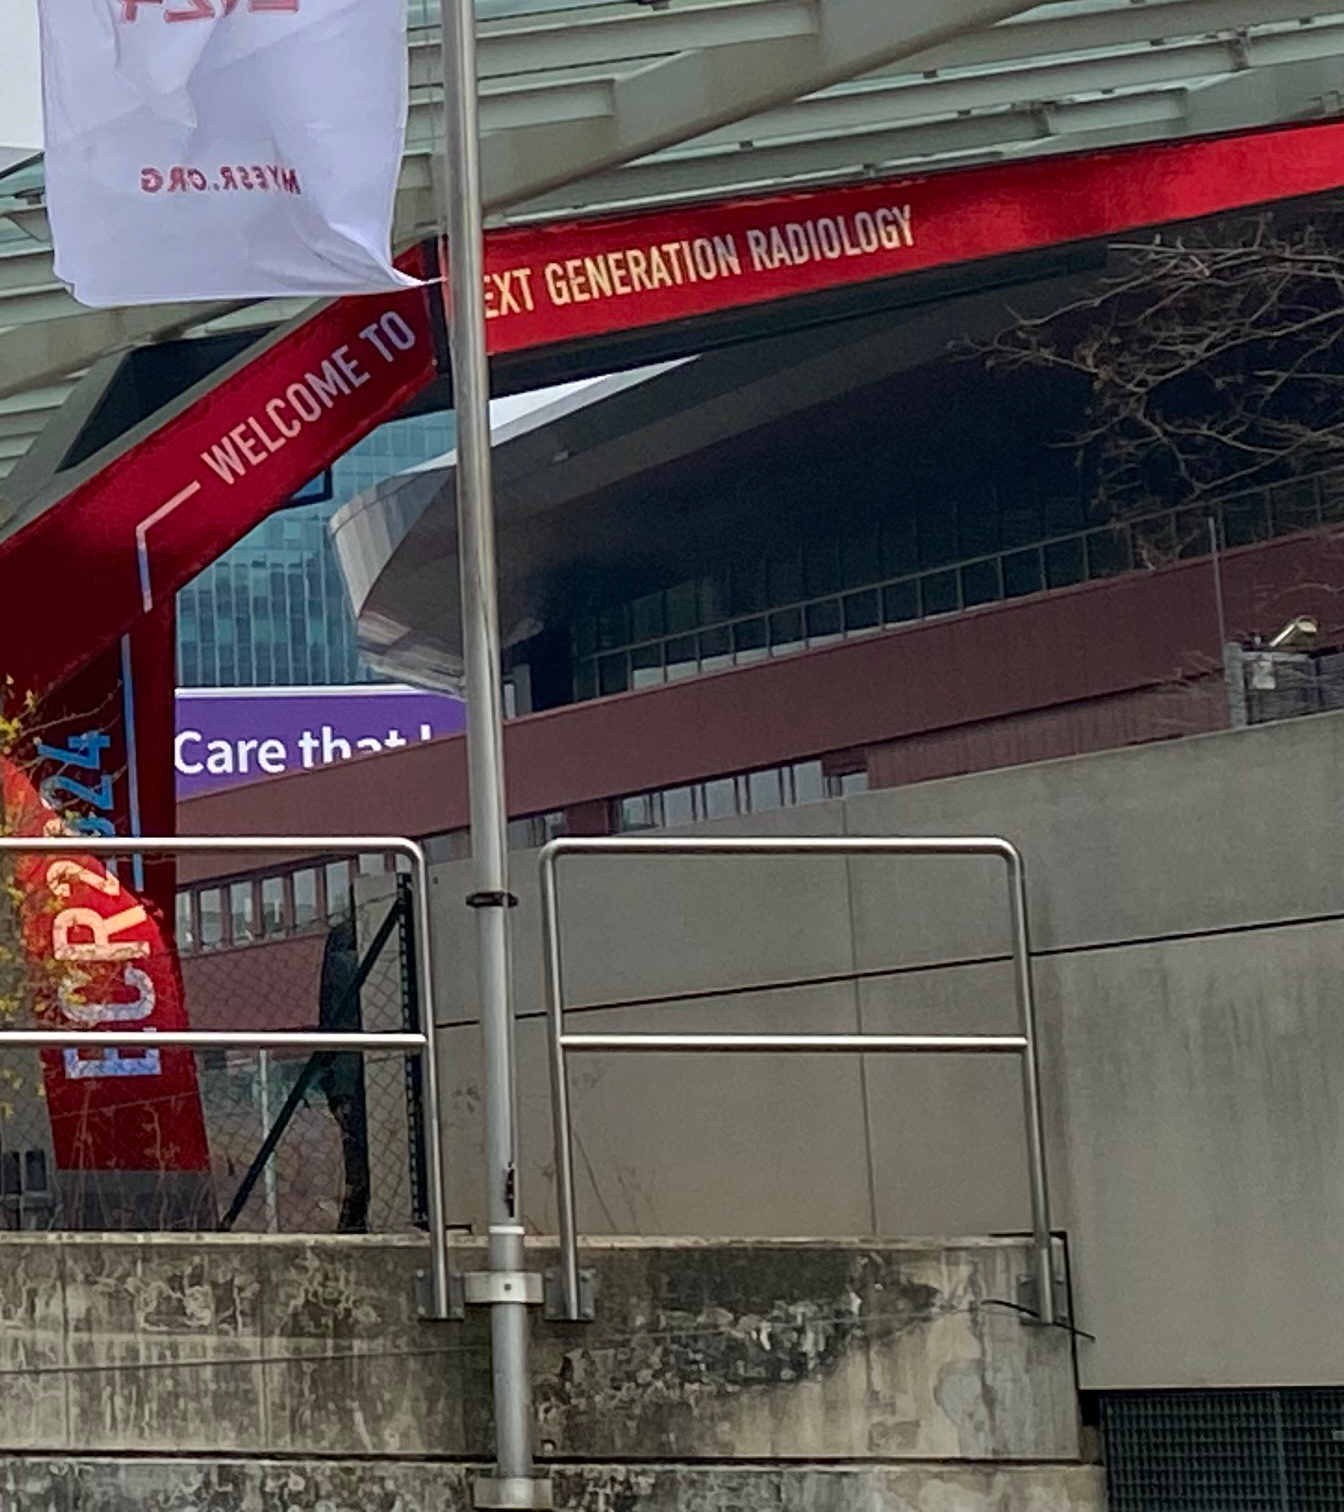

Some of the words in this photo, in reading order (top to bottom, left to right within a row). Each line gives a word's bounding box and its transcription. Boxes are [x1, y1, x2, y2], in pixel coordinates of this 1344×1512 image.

[483, 266, 535, 319] EXT
[544, 233, 742, 306] GENERATION
[749, 204, 915, 271] RADIOLOGY
[199, 344, 372, 485] WELCOME
[358, 310, 416, 363] TO
[174, 730, 287, 775] Care
